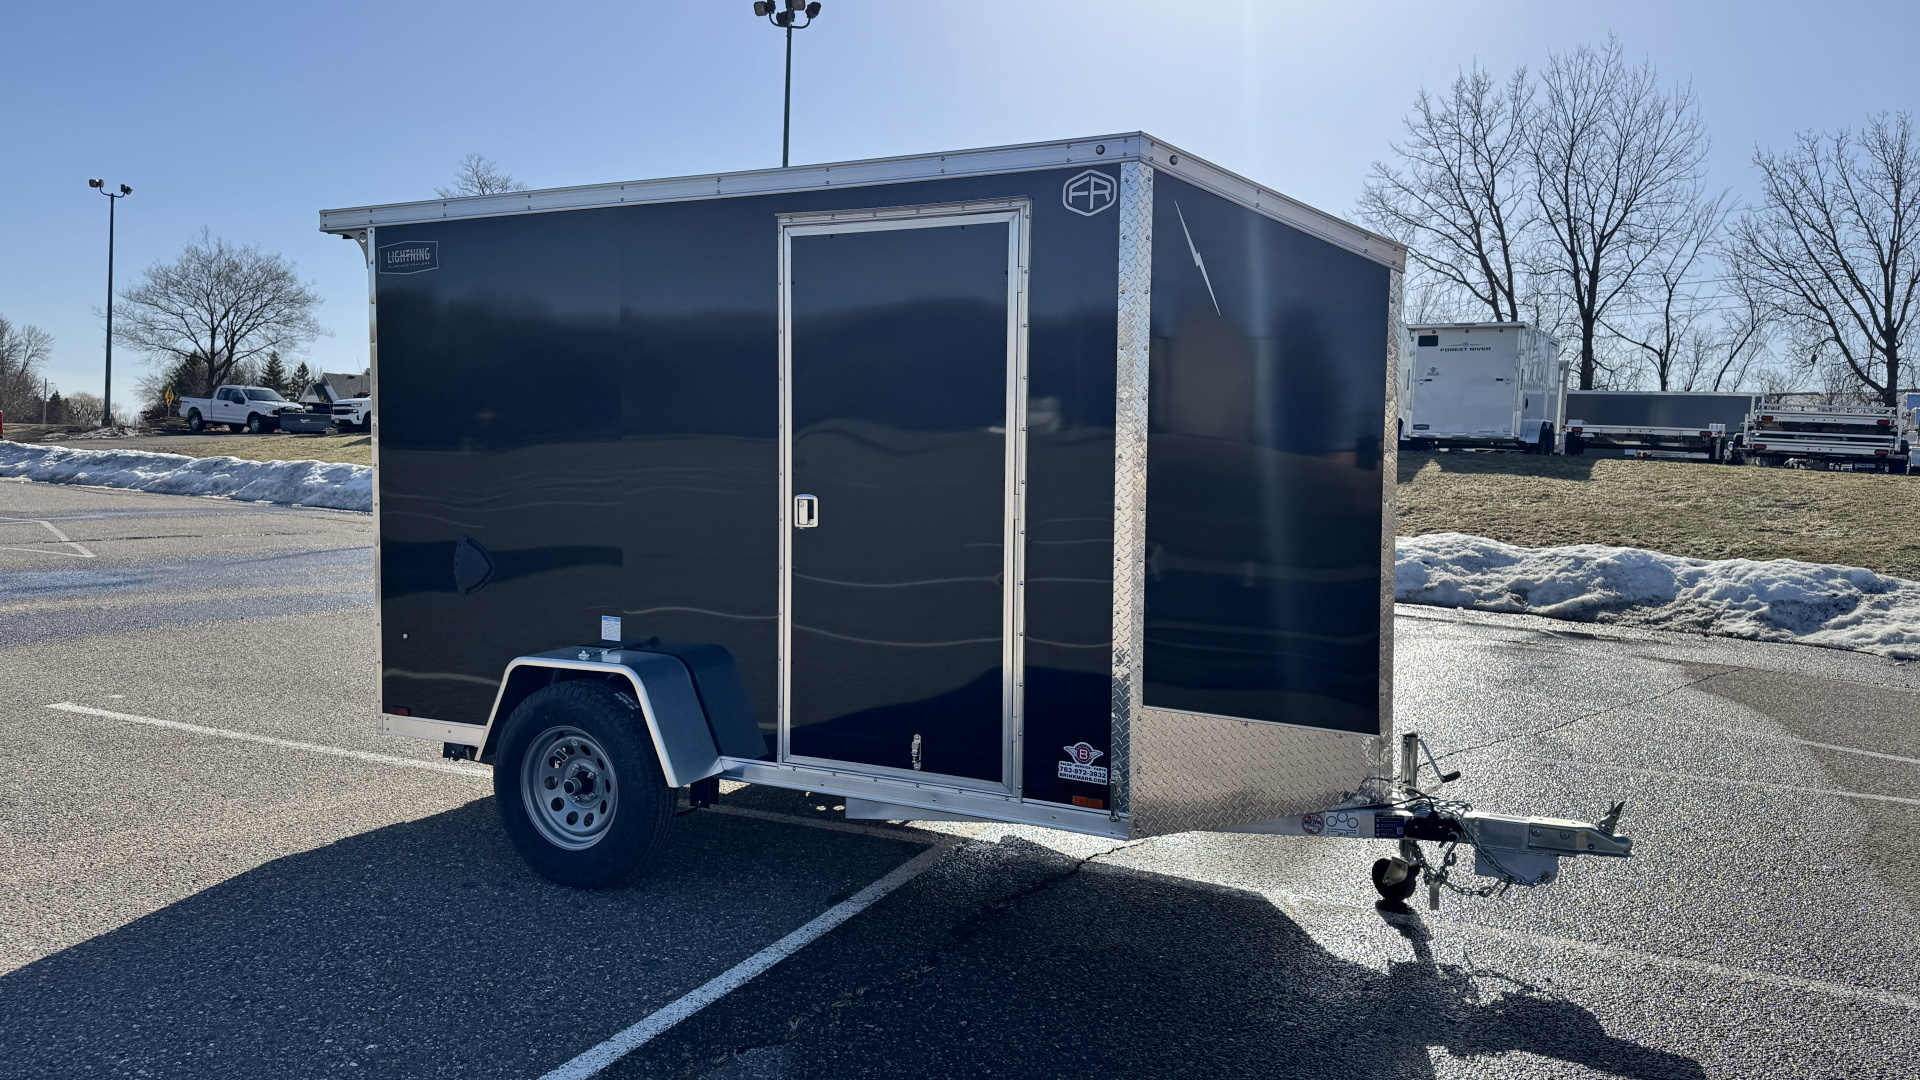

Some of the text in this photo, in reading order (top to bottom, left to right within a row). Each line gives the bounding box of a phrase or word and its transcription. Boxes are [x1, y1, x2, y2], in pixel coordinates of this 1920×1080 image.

[388, 248, 430, 263] LIGHTNING
[1080, 749, 1088, 760] B
[1060, 766, 1106, 778] 763-972-3932
[1060, 772, 1106, 784] BRINKMANS.COM
